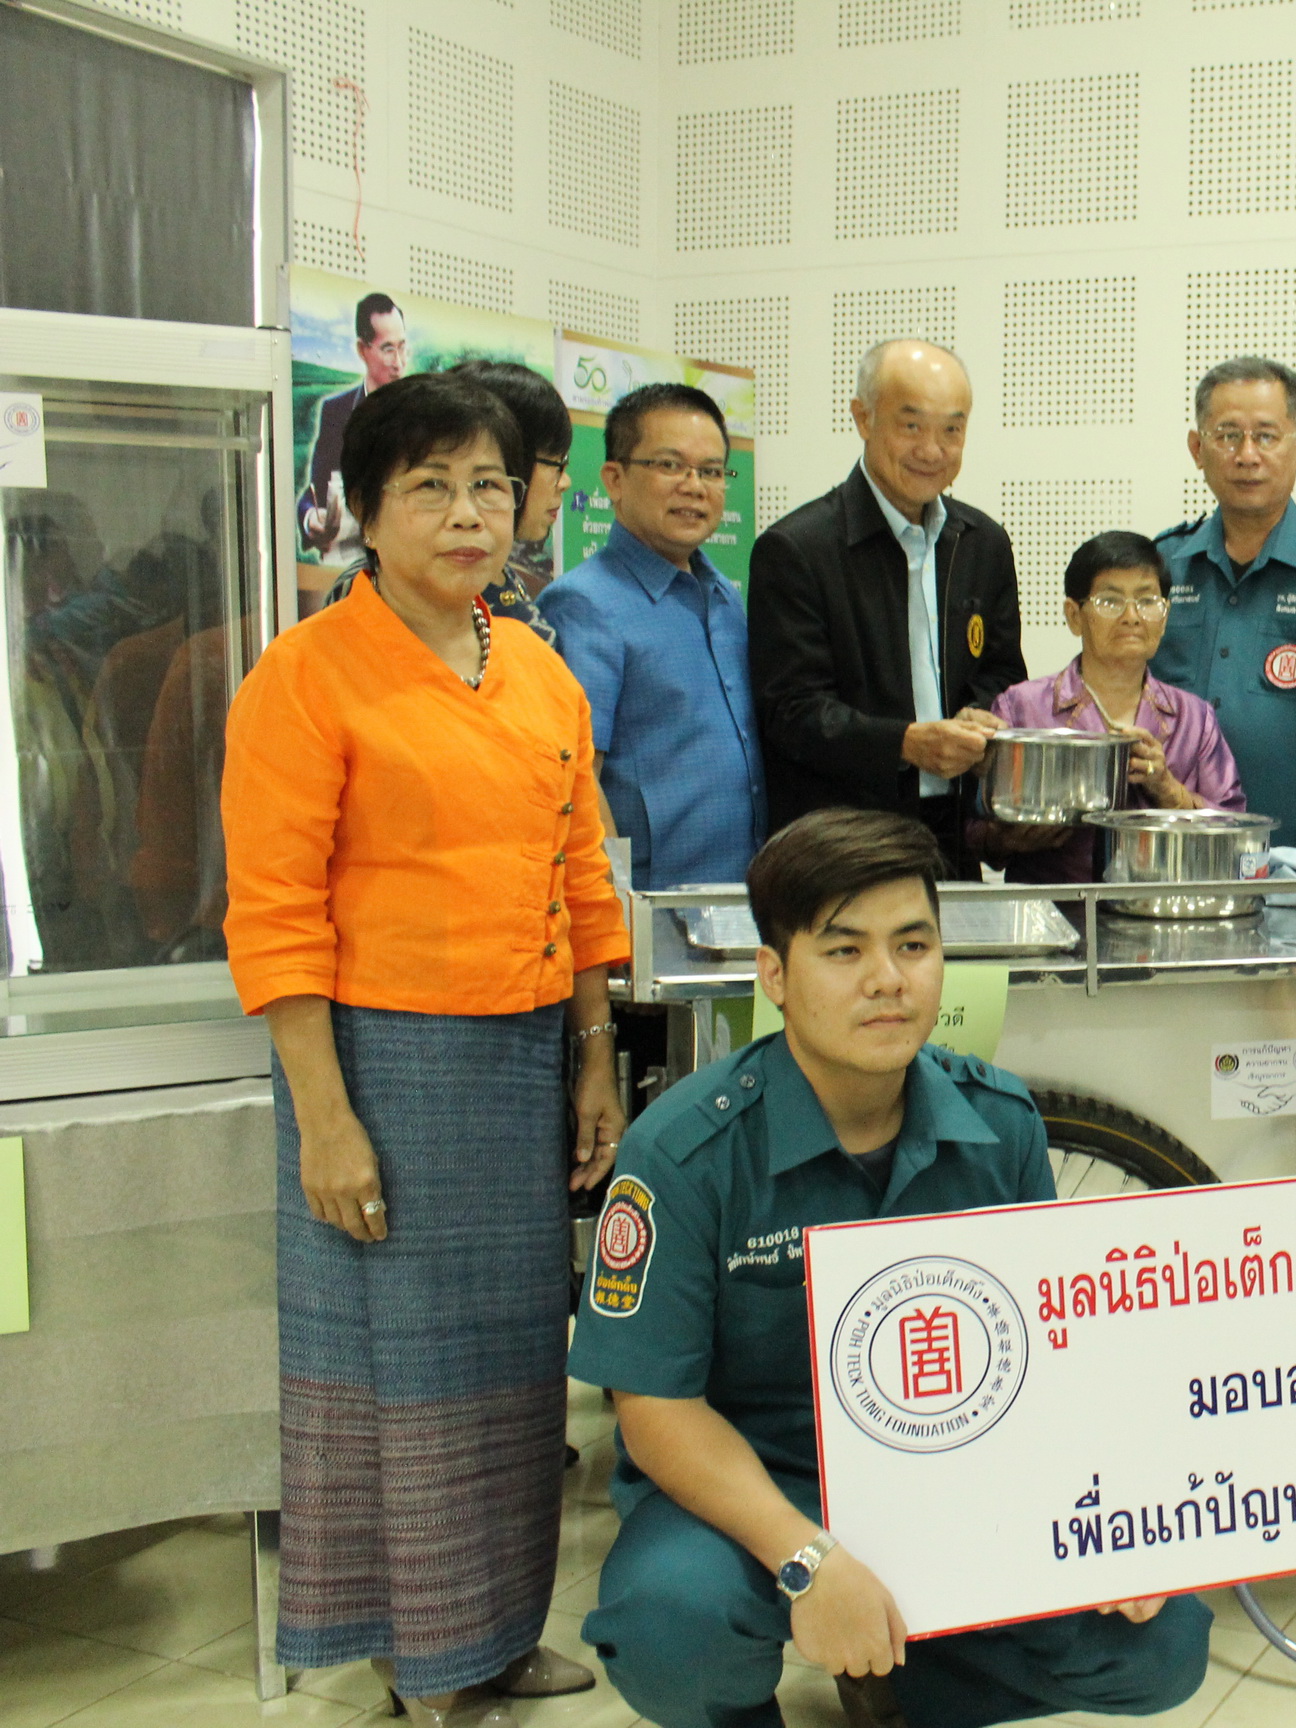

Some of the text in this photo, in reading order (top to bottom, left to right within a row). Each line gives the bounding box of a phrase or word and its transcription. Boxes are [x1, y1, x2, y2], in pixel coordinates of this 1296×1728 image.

[871, 1269, 985, 1312] มูลนิธิป่อเต็กตึ๊ง
[847, 1318, 971, 1438] POH TECK TUNG FOUNDATION
